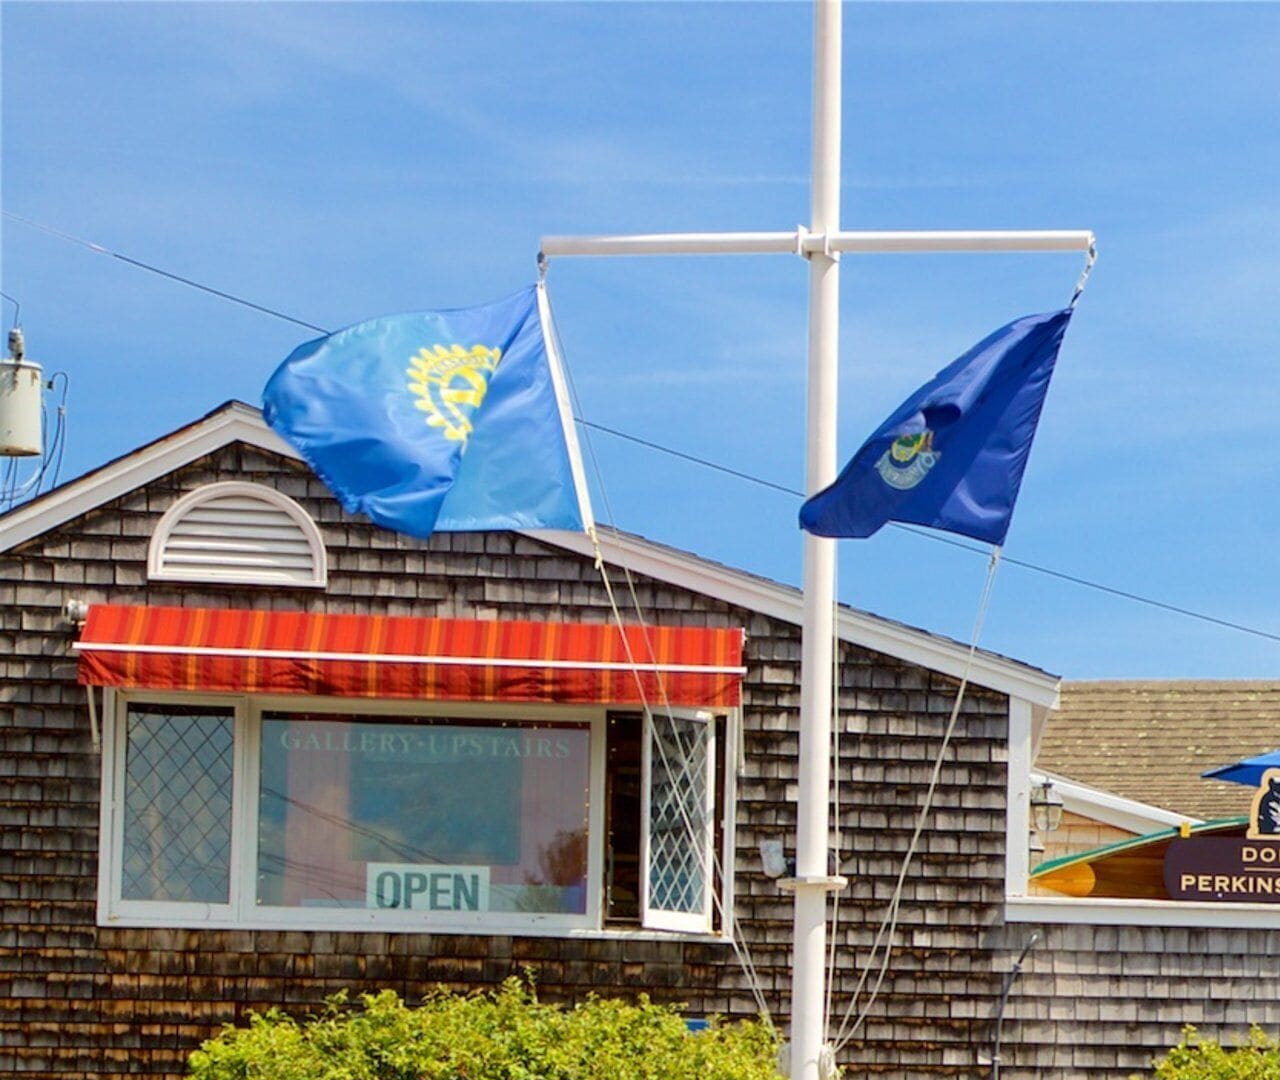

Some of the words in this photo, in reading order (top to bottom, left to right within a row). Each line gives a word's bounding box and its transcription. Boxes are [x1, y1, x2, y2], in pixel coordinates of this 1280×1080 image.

[280, 730, 412, 754] GALLERY
[428, 733, 571, 760] UPSTAIRS
[376, 871, 480, 911] OPEN
